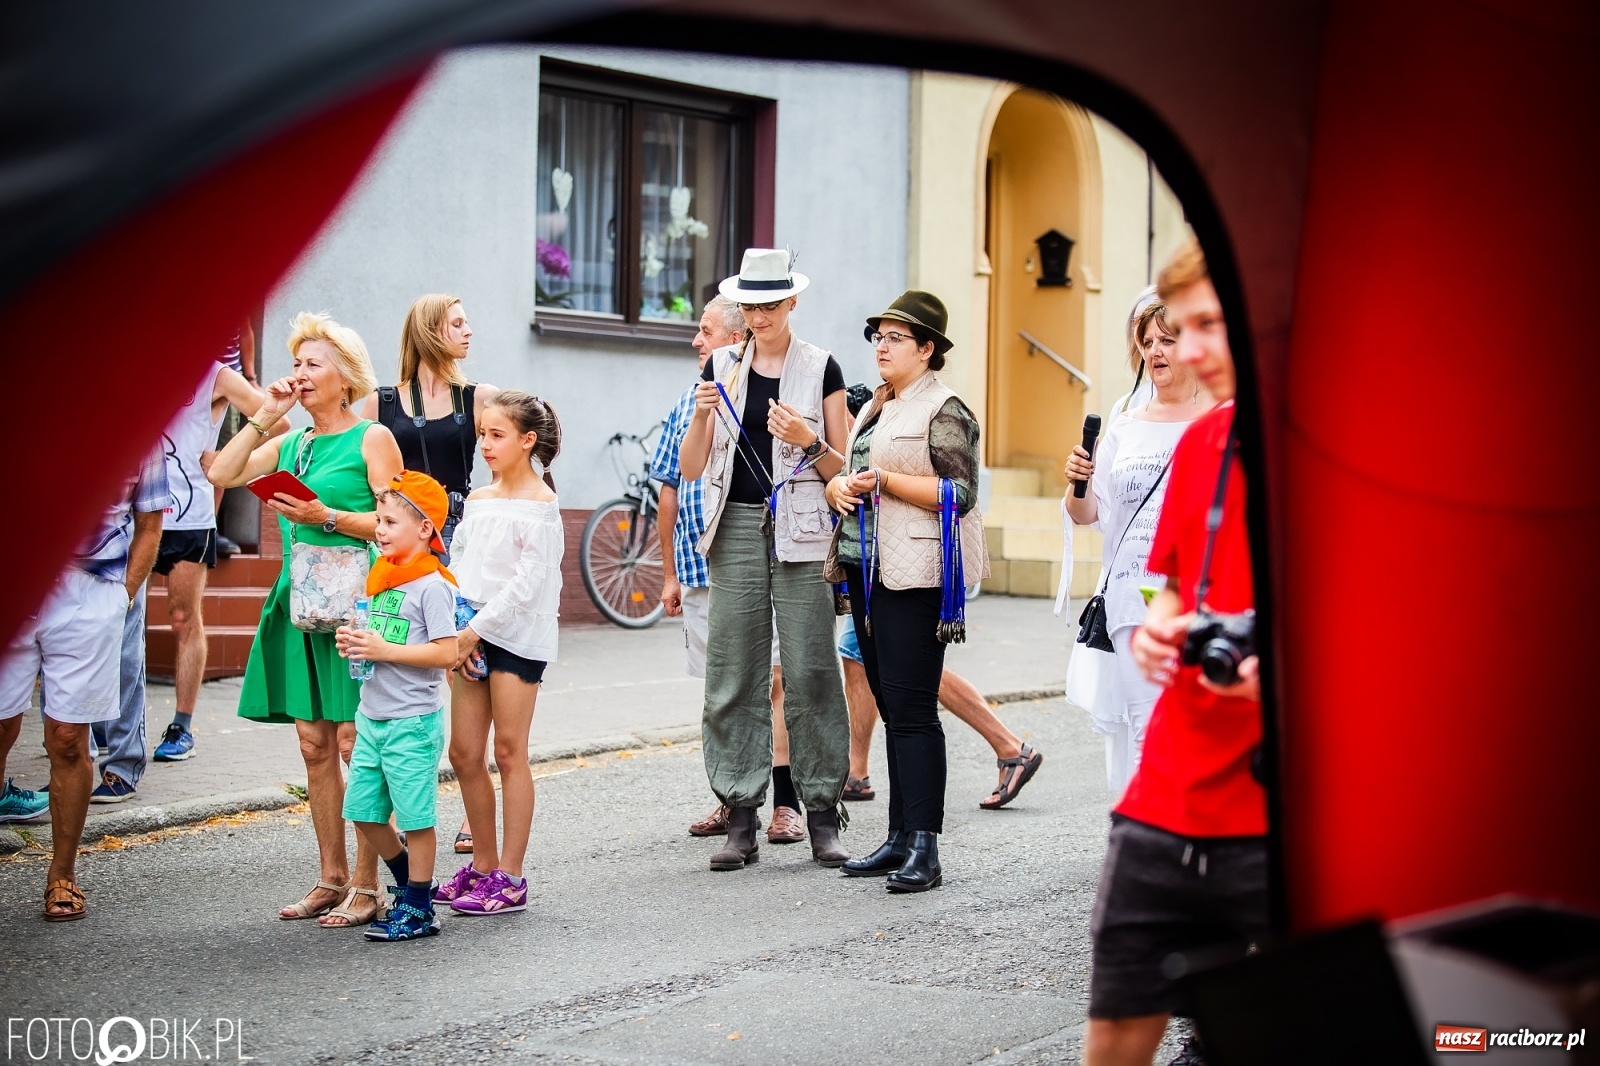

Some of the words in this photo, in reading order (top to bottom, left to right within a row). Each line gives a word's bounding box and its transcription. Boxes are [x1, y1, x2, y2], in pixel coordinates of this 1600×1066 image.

[1126, 475, 1143, 493] the
[387, 595, 399, 608] Mg
[392, 624, 401, 635] N
